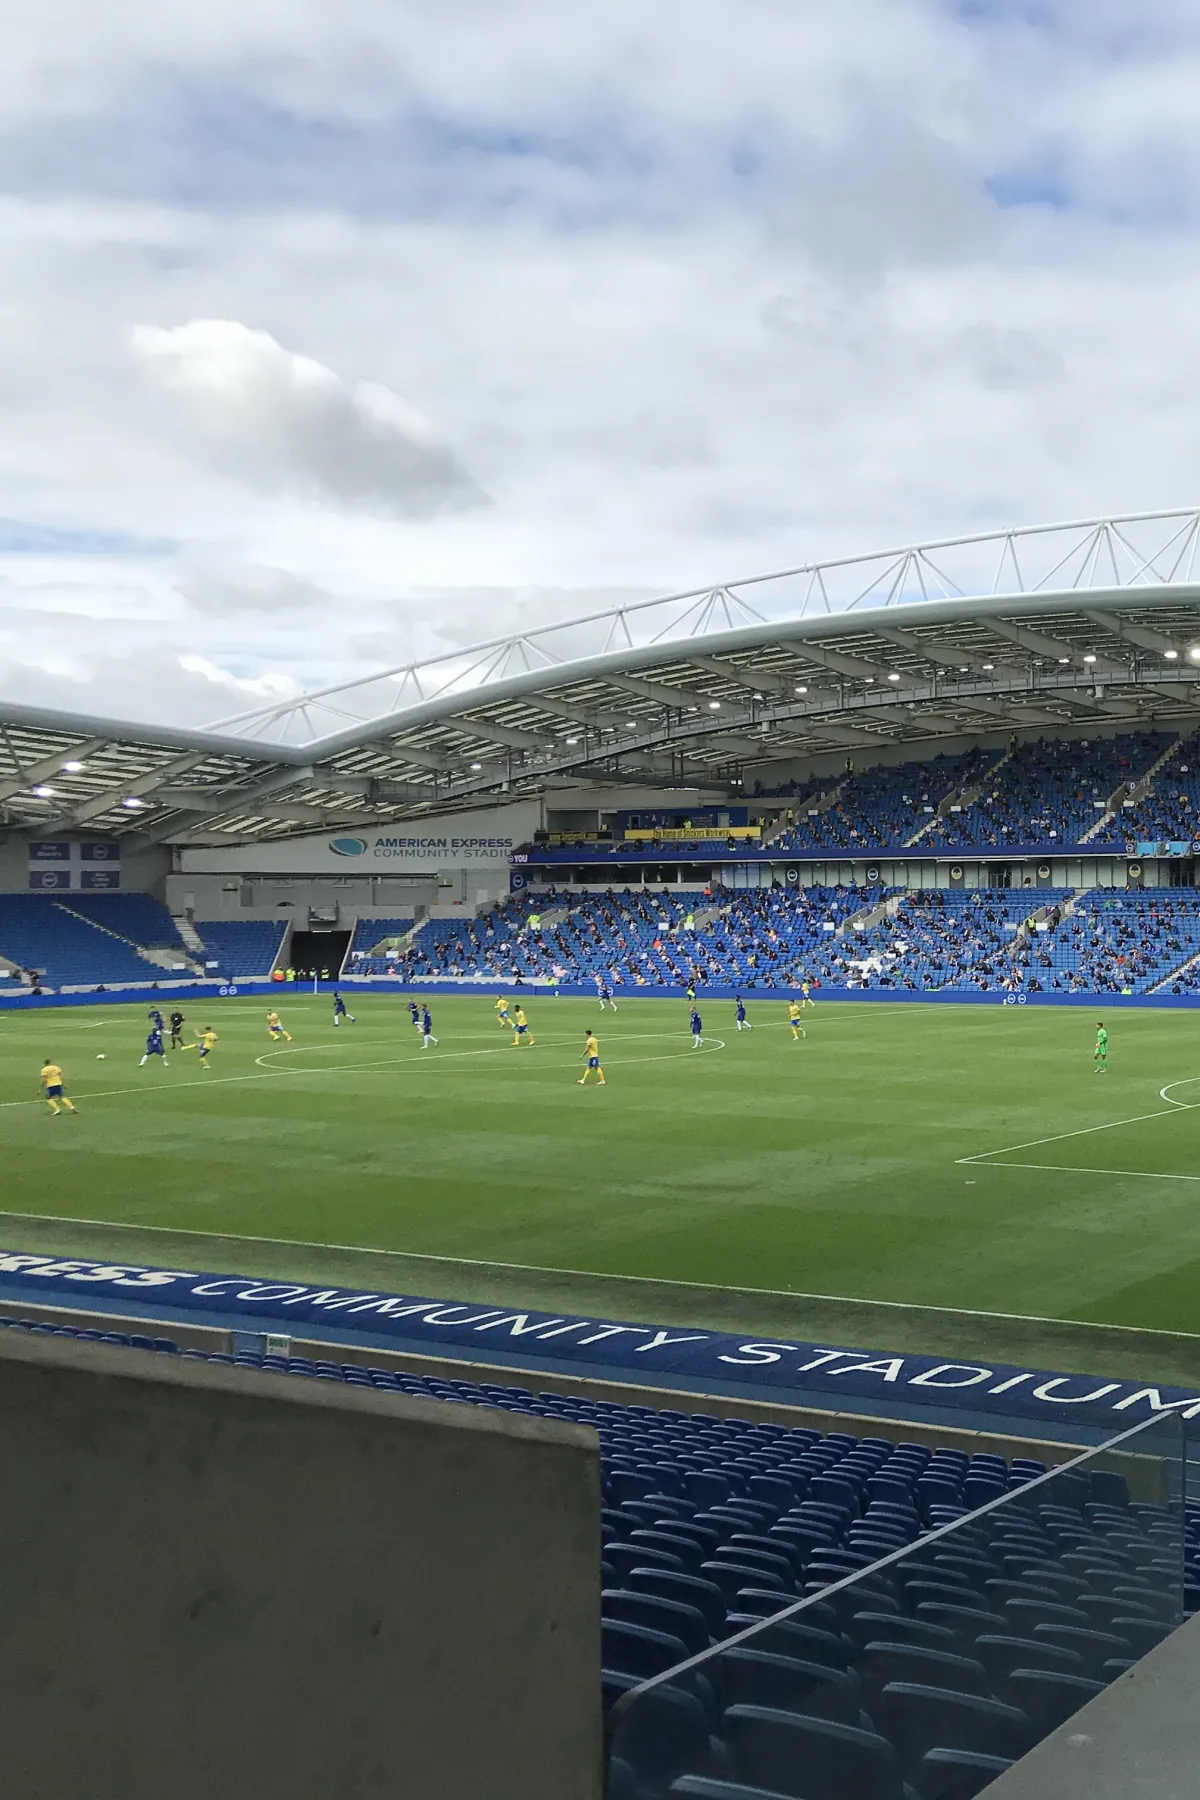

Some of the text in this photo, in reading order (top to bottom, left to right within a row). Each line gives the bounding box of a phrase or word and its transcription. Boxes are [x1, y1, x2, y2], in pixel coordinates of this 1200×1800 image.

[375, 838, 513, 848] AMERICAN EXPRESS
[373, 848, 514, 858] COMMUNITY STADIU
[513, 854, 528, 863] YOU
[191, 1279, 709, 1351] COMMUNITY
